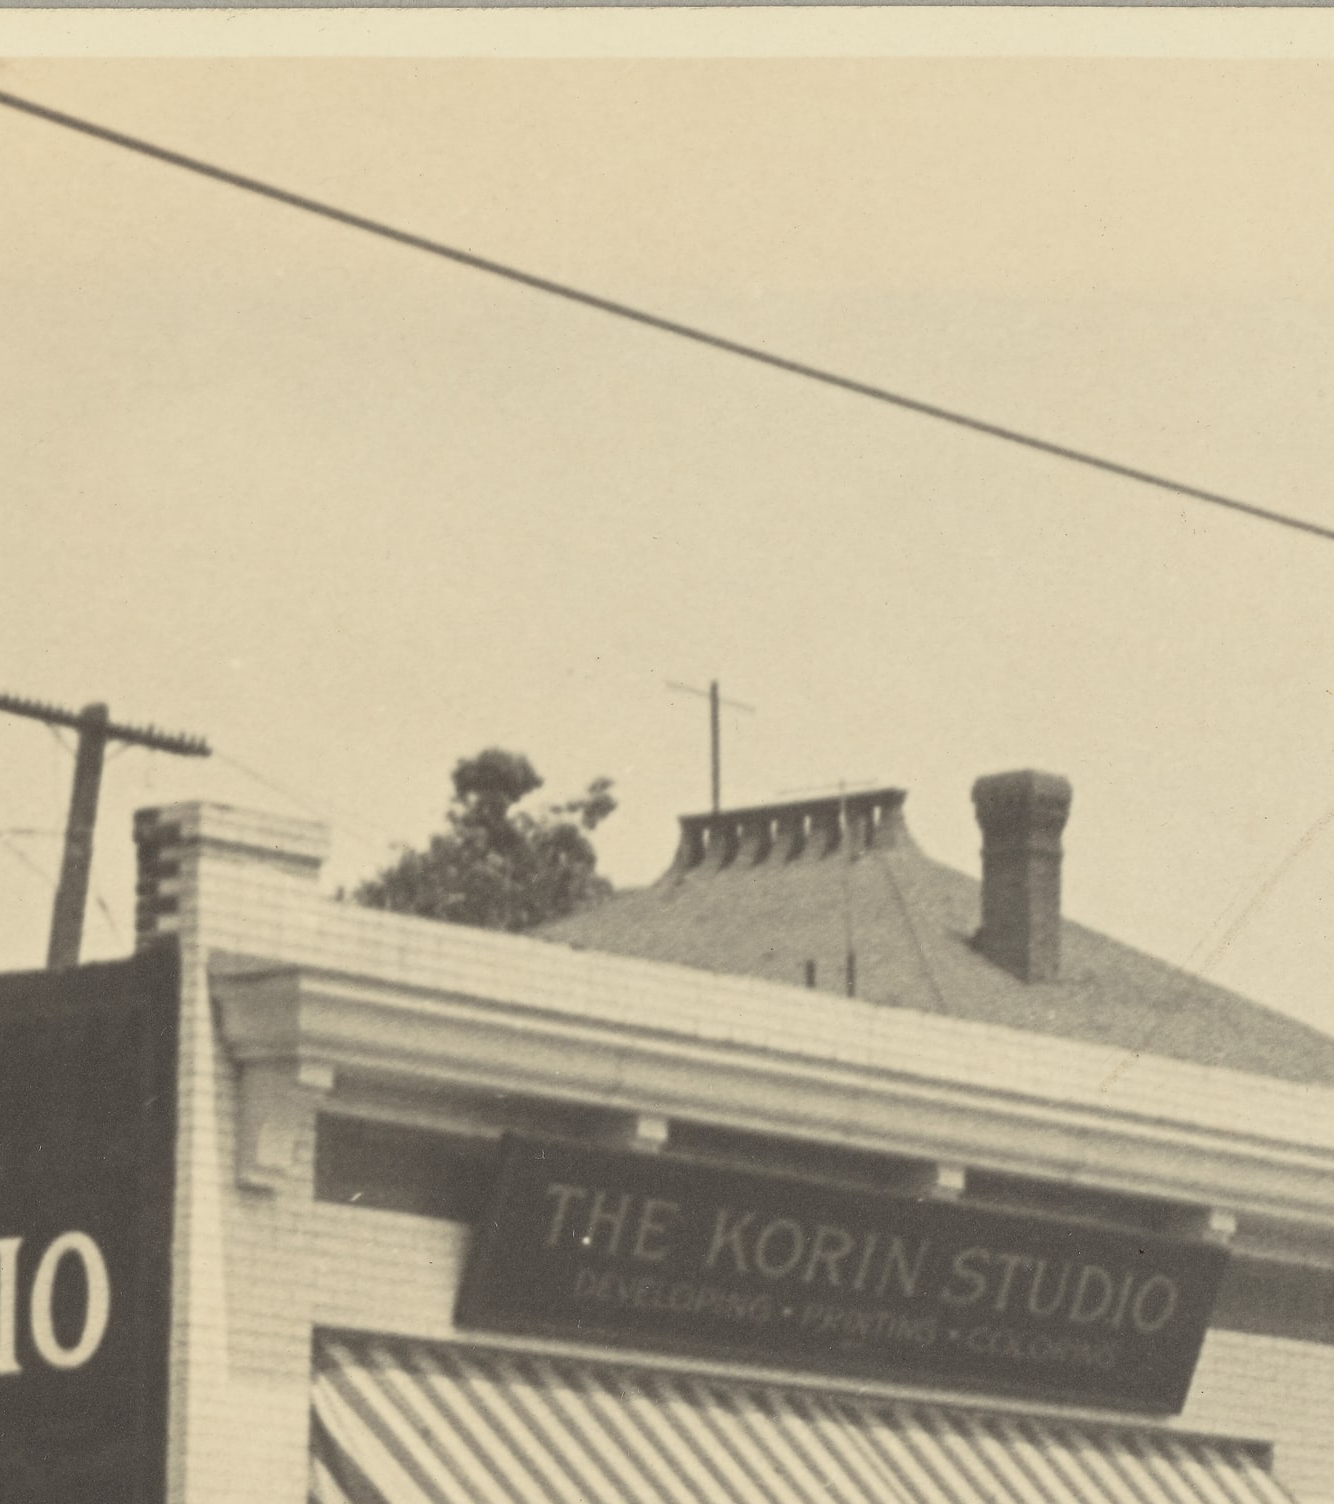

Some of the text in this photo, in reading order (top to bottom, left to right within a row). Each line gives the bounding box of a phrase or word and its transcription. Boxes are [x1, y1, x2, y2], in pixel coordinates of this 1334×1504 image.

[547, 1183, 1179, 1335] THE KORIN STUDIO
